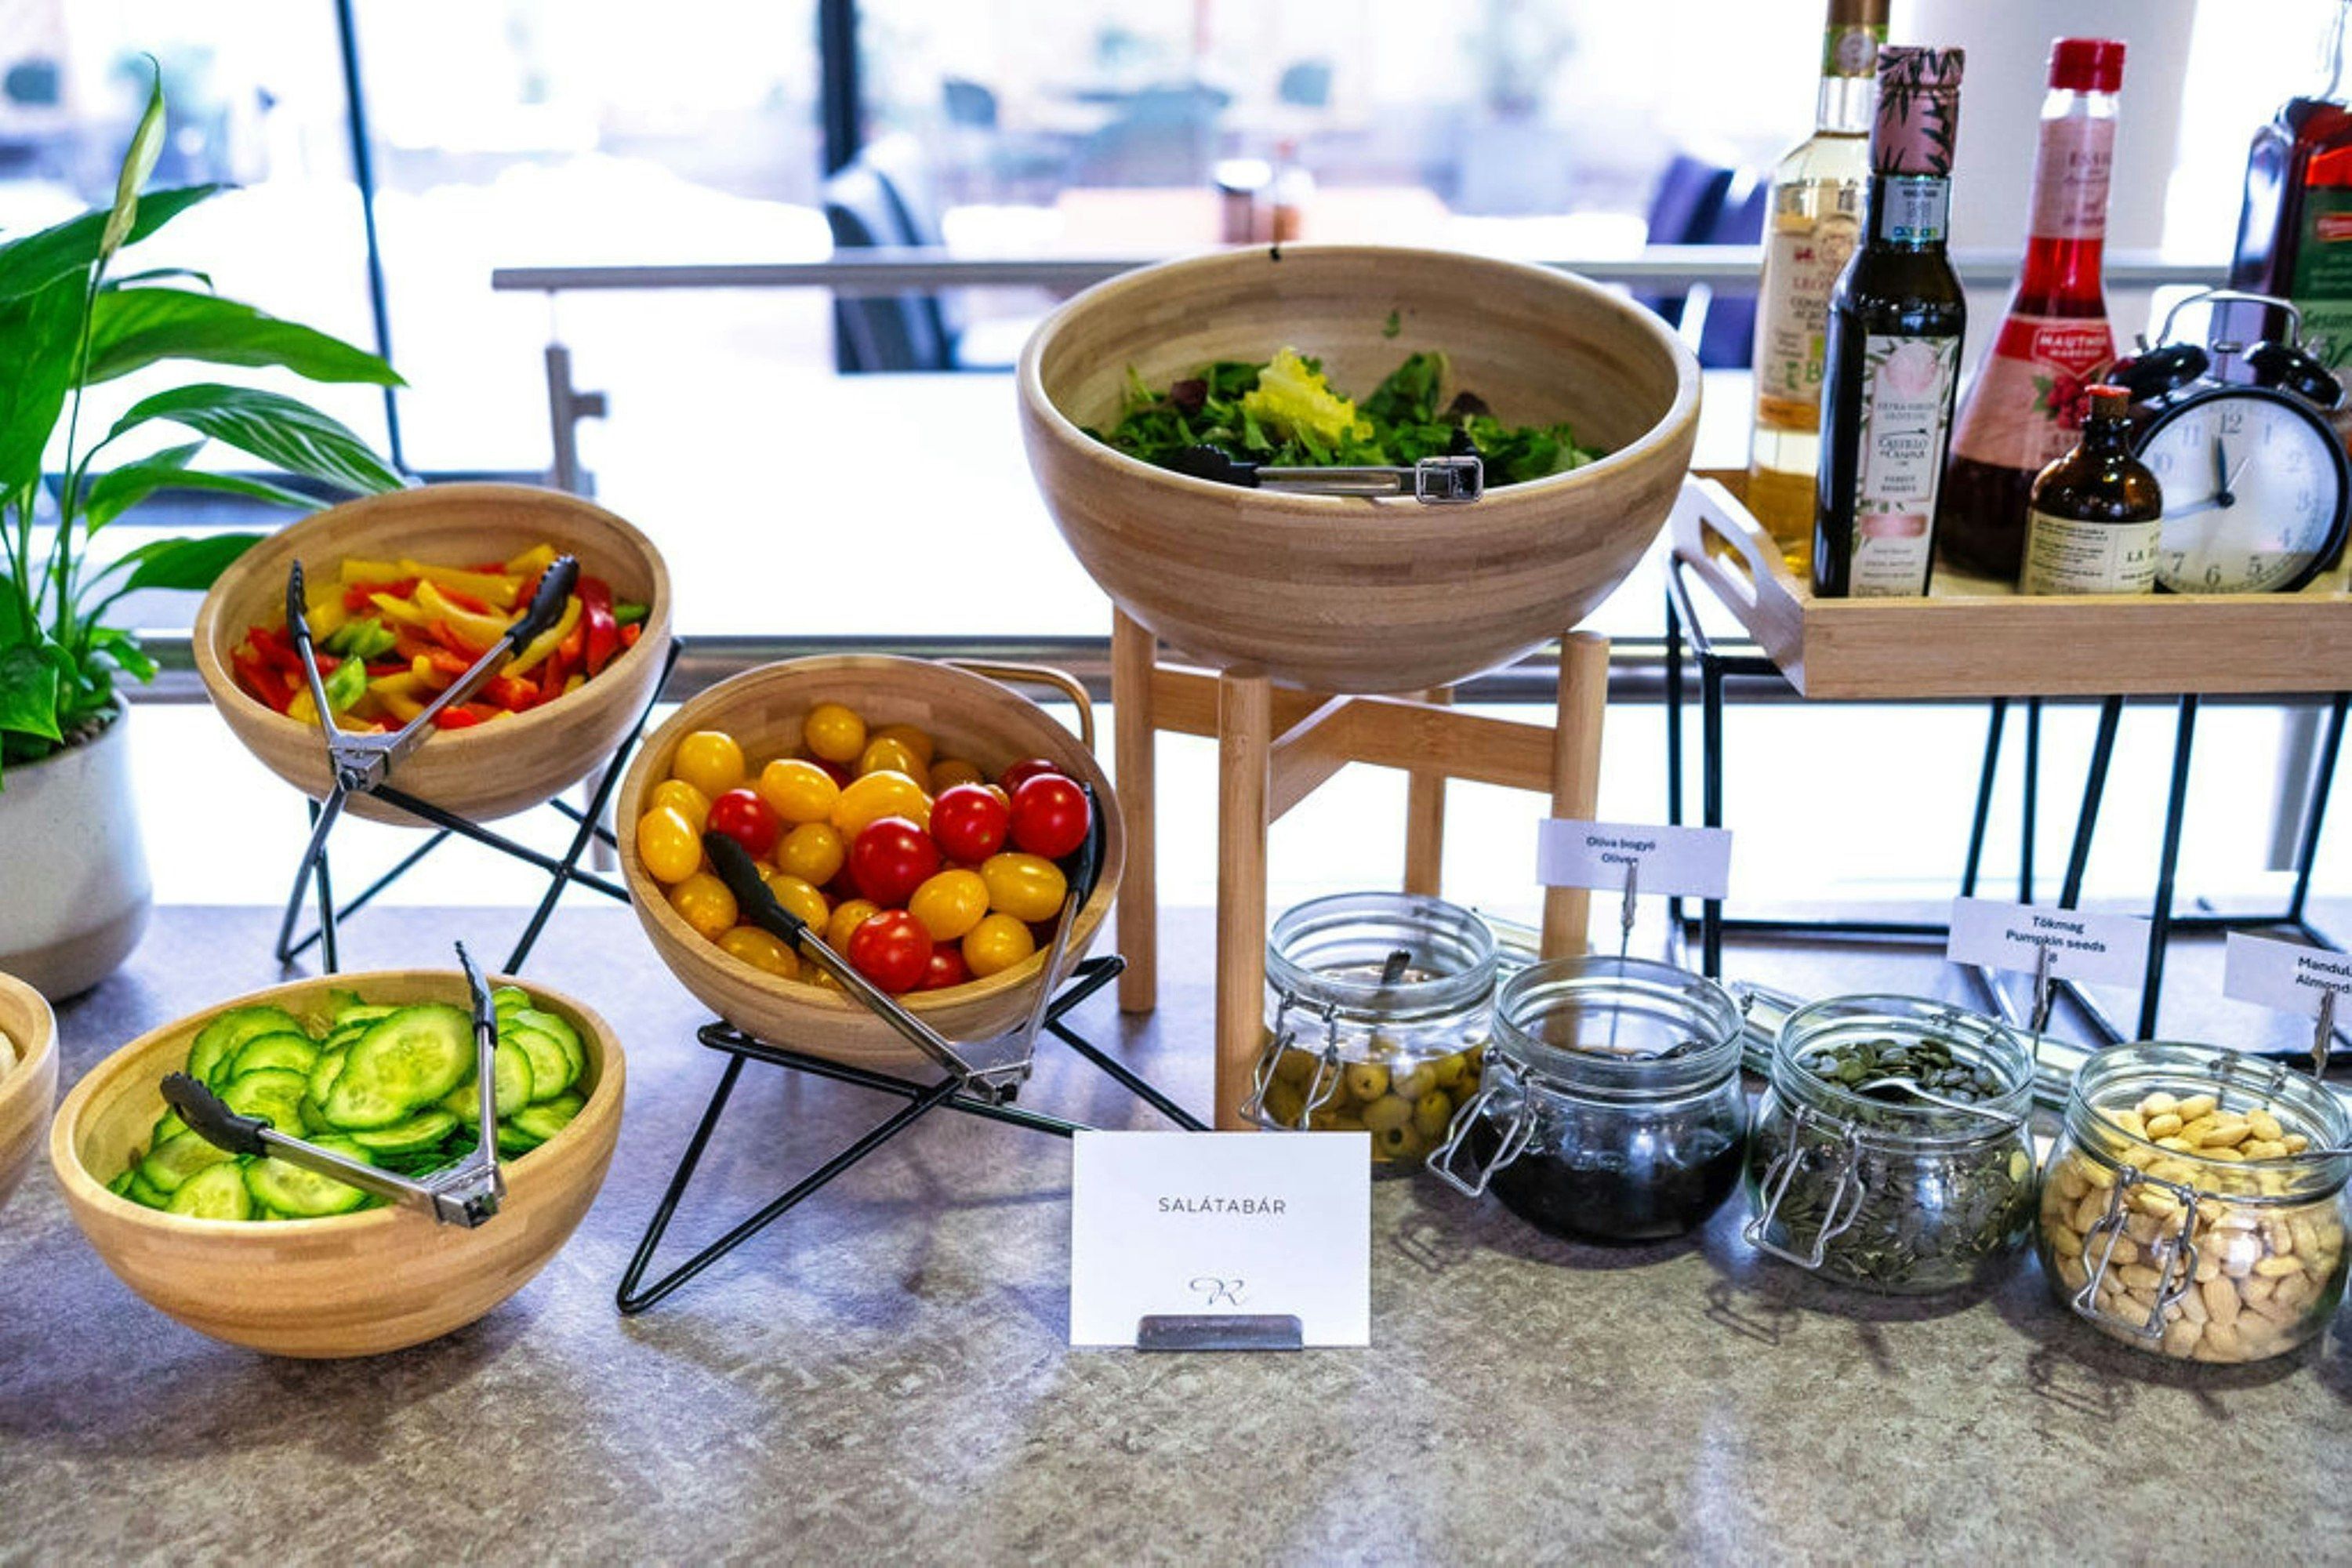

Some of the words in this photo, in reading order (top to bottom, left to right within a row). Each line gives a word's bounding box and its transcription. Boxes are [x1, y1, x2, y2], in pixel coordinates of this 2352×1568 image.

[2220, 412, 2241, 434] 12
[2182, 424, 2201, 446] 11
[2172, 551, 2185, 572] 7
[2249, 554, 2263, 576] 5
[2205, 564, 2221, 586] 6
[1585, 835, 1617, 848] Oliva
[2033, 915, 2085, 935] Tökmag
[2005, 928, 2064, 947] Pumpkin
[2066, 939, 2107, 953] seeds
[2298, 956, 2352, 978] Mandul
[1158, 1195, 1287, 1215] SALÁTABÁR
